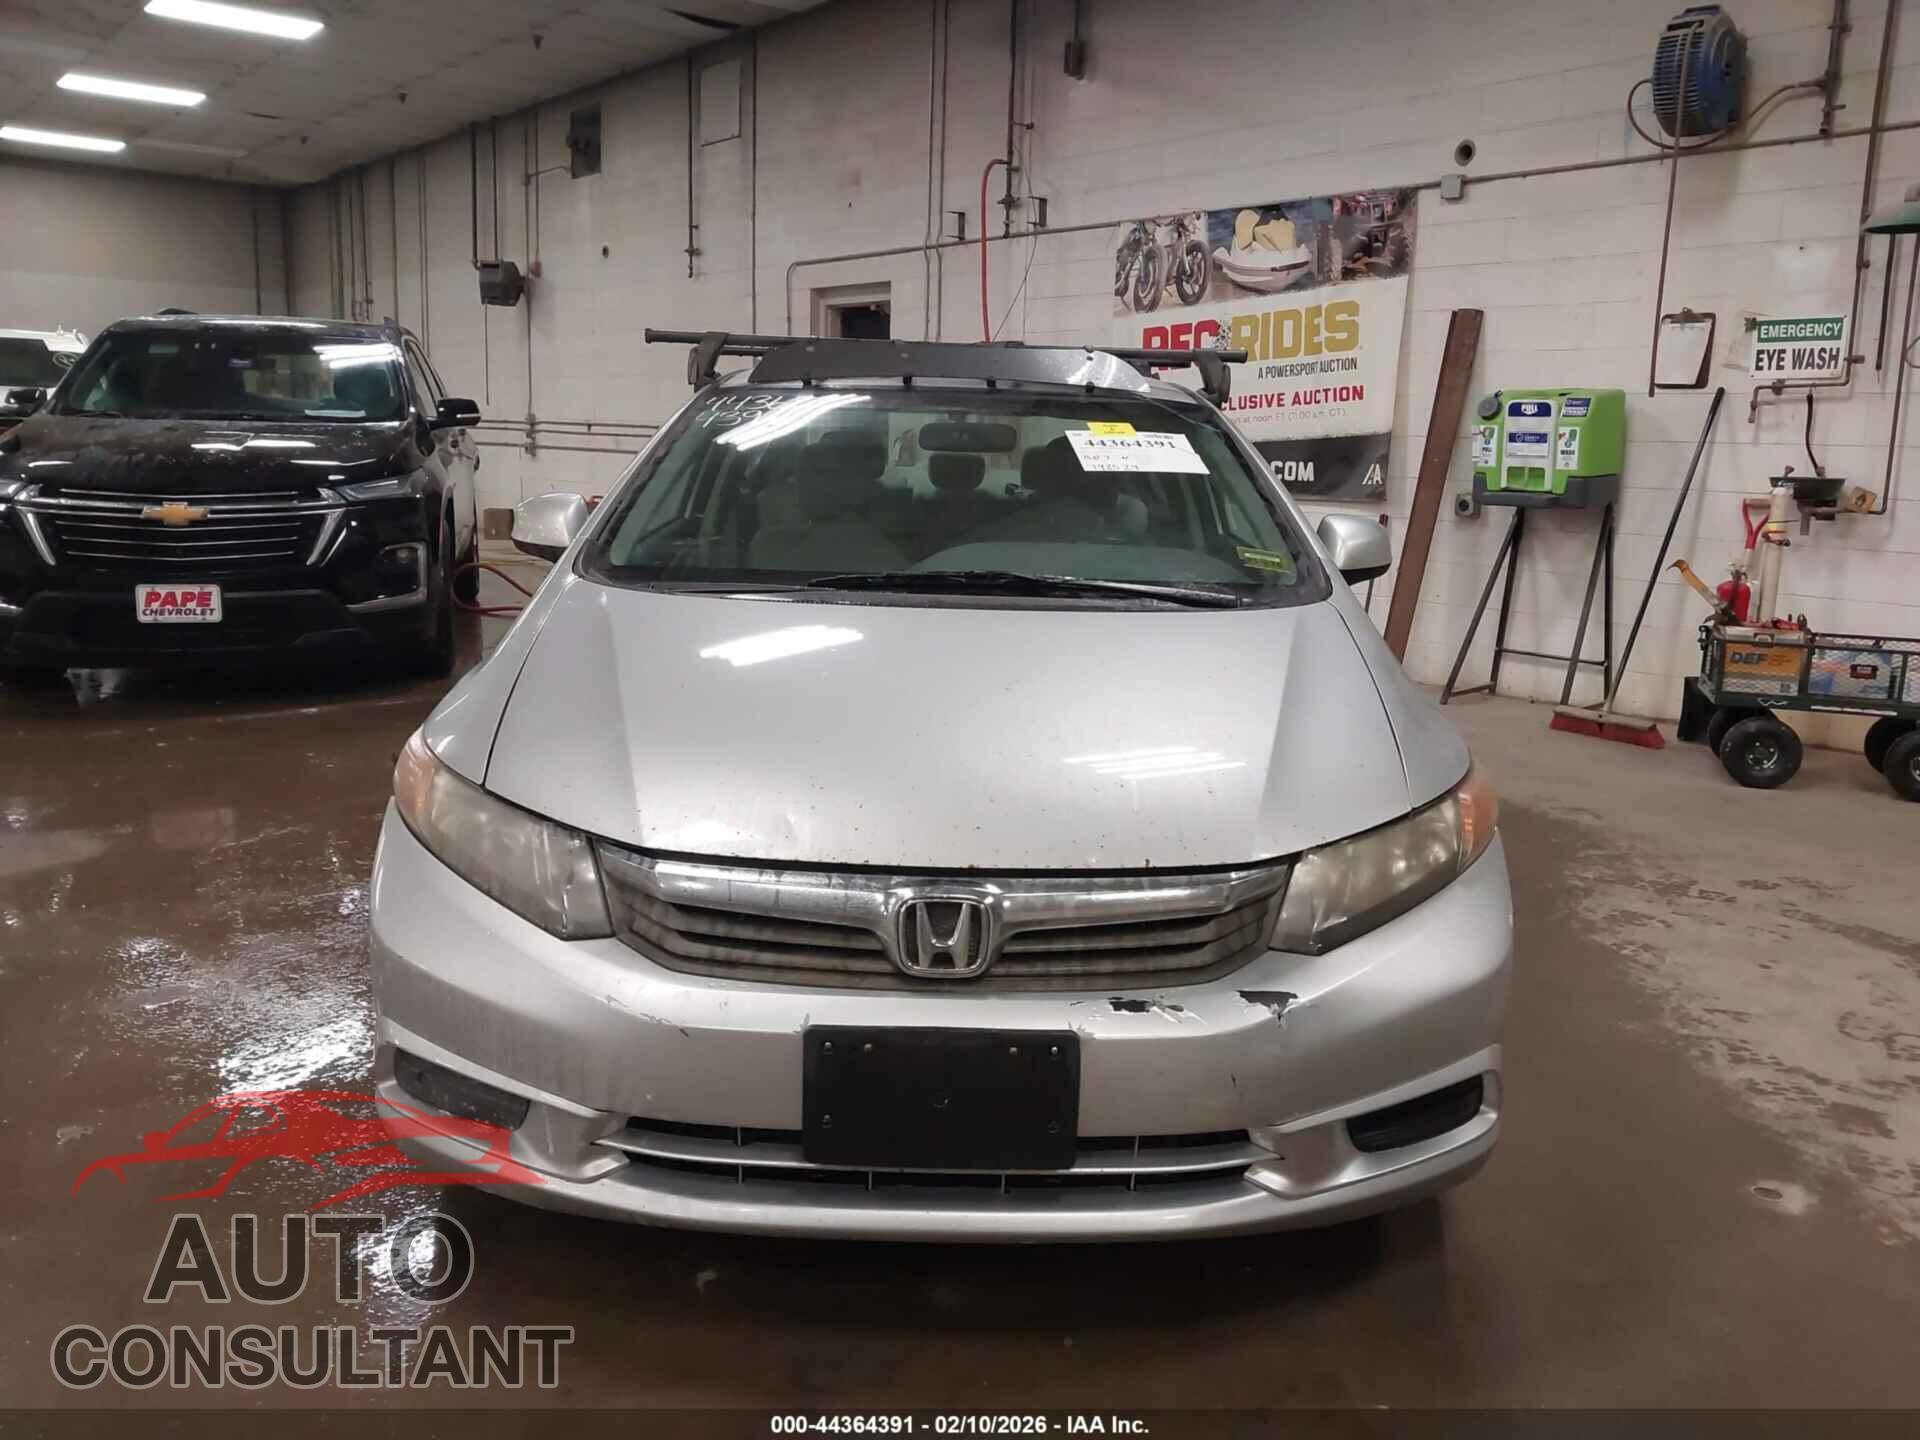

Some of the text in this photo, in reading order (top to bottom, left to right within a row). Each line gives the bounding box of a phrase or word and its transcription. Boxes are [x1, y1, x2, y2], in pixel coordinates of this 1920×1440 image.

[1231, 300, 1361, 362] RIDES
[1760, 322, 1842, 338] EMERGENCY
[1258, 357, 1358, 380] A POWERSPORT AUCTION
[1755, 347, 1841, 371] EYE WASH
[1220, 385, 1365, 412] CLUSIVE AUCTION
[1270, 460, 1315, 482] COM
[144, 591, 213, 608] PAPE
[142, 608, 217, 617] CHEVROLET
